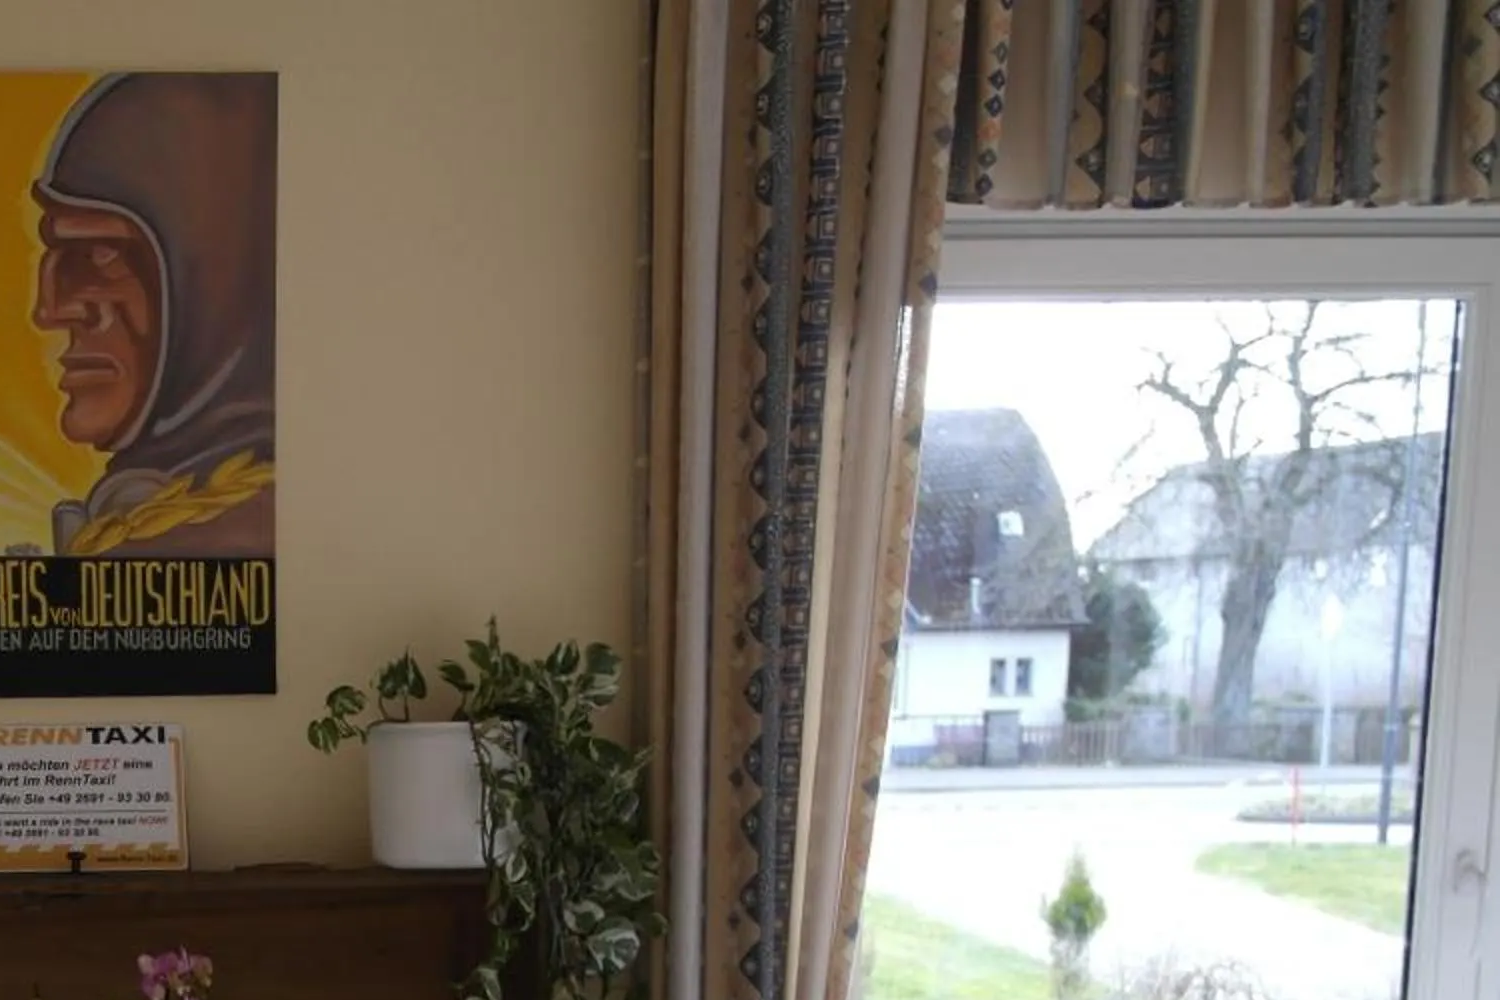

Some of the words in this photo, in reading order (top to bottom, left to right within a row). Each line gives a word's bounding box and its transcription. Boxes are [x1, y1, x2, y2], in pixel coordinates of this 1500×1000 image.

[80, 560, 270, 627] DEUTSCHLAND
[29, 628, 65, 651] AUF
[69, 628, 108, 650] DEM
[73, 757, 120, 771] JETZT
[123, 759, 153, 769] eine
[22, 774, 41, 786] im
[24, 793, 45, 804] Sie
